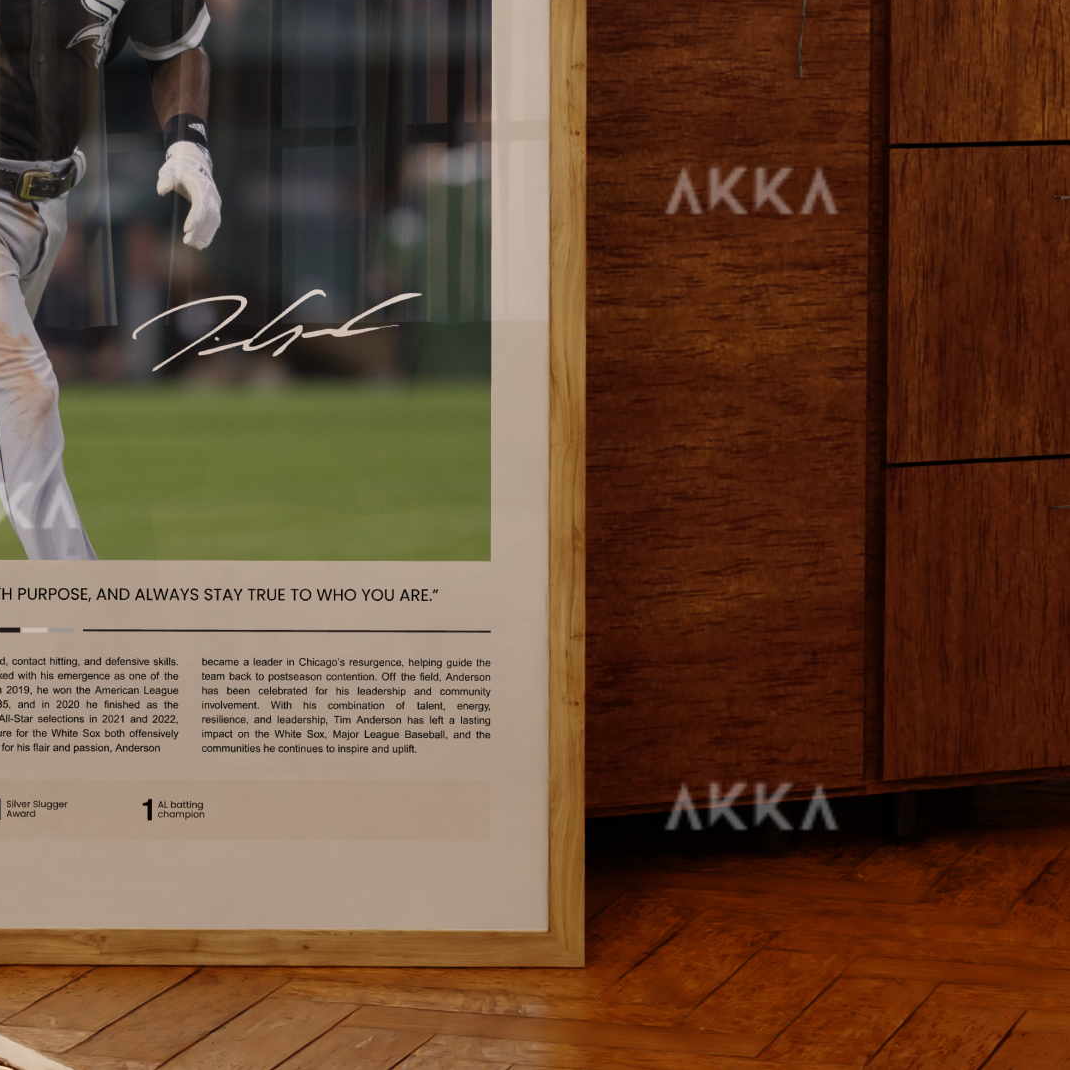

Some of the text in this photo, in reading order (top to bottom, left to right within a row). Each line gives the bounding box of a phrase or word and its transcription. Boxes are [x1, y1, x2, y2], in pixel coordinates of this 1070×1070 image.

[17, 587, 92, 604] PURPOSE,
[95, 587, 131, 601] AND
[134, 587, 200, 602] ALWAYS
[203, 587, 244, 602] STAY
[246, 587, 286, 602] TRUE
[289, 587, 313, 602] TO
[316, 587, 357, 602] WHO
[360, 588, 395, 602] YOU
[399, 588, 439, 602] ARE.”
[11, 656, 47, 666] contact
[49, 656, 81, 668] hitting,
[83, 656, 102, 666] and
[104, 656, 151, 667] defensive
[152, 656, 179, 667] skills.
[201, 657, 492, 670] became a leader in Chicago’s resurgence, helping guide the
[17, 670, 37, 681] with
[40, 670, 55, 681] his
[57, 672, 111, 683] emergence
[113, 672, 126, 681] as
[128, 672, 147, 681] one
[149, 670, 161, 681] of
[163, 671, 180, 681] the
[201, 671, 492, 683] team back to postseason contention. Off the field, Anderson
[6, 799, 69, 811] Silver Slugger
[142, 799, 152, 821] 1
[157, 800, 204, 811] AL batting
[6, 809, 36, 818] Award
[157, 809, 206, 821] champion
